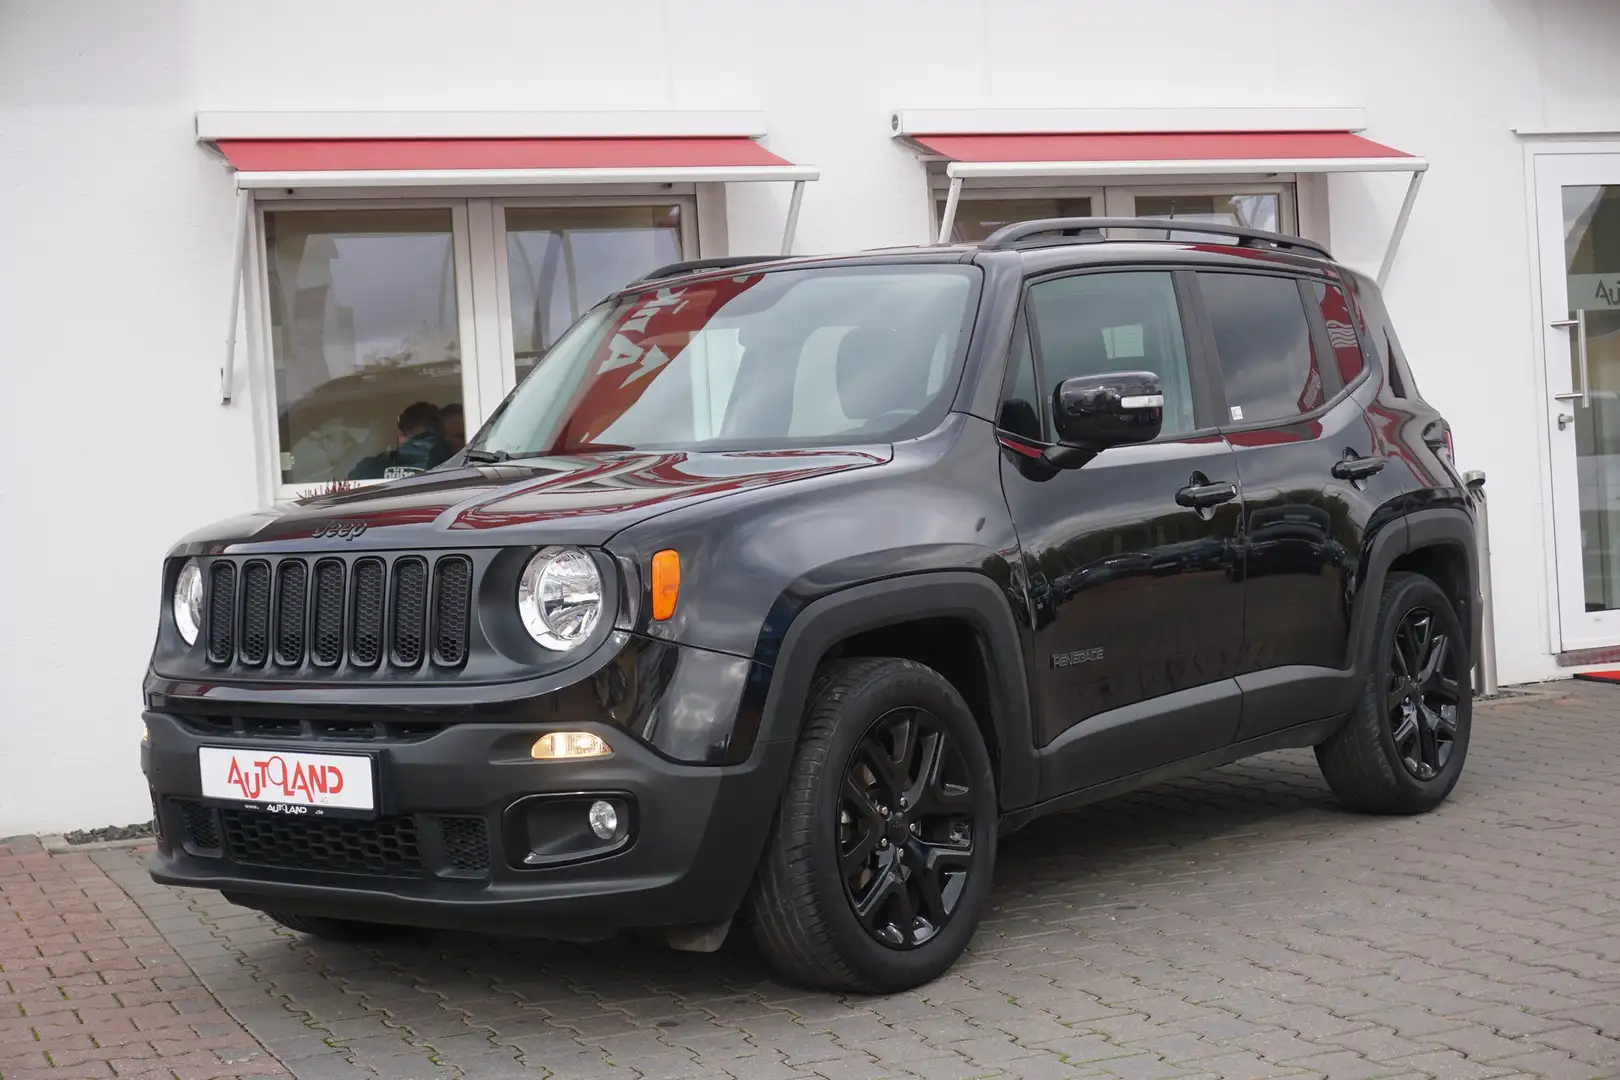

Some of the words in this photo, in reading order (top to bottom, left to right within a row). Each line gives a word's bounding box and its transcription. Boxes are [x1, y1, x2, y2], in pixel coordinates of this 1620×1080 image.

[1595, 279, 1620, 306] AU
[311, 521, 367, 541] Jeep
[1052, 647, 1105, 669] RENEGADE
[227, 755, 344, 803] AUTOLAND
[266, 803, 308, 815] AUTOLAND
